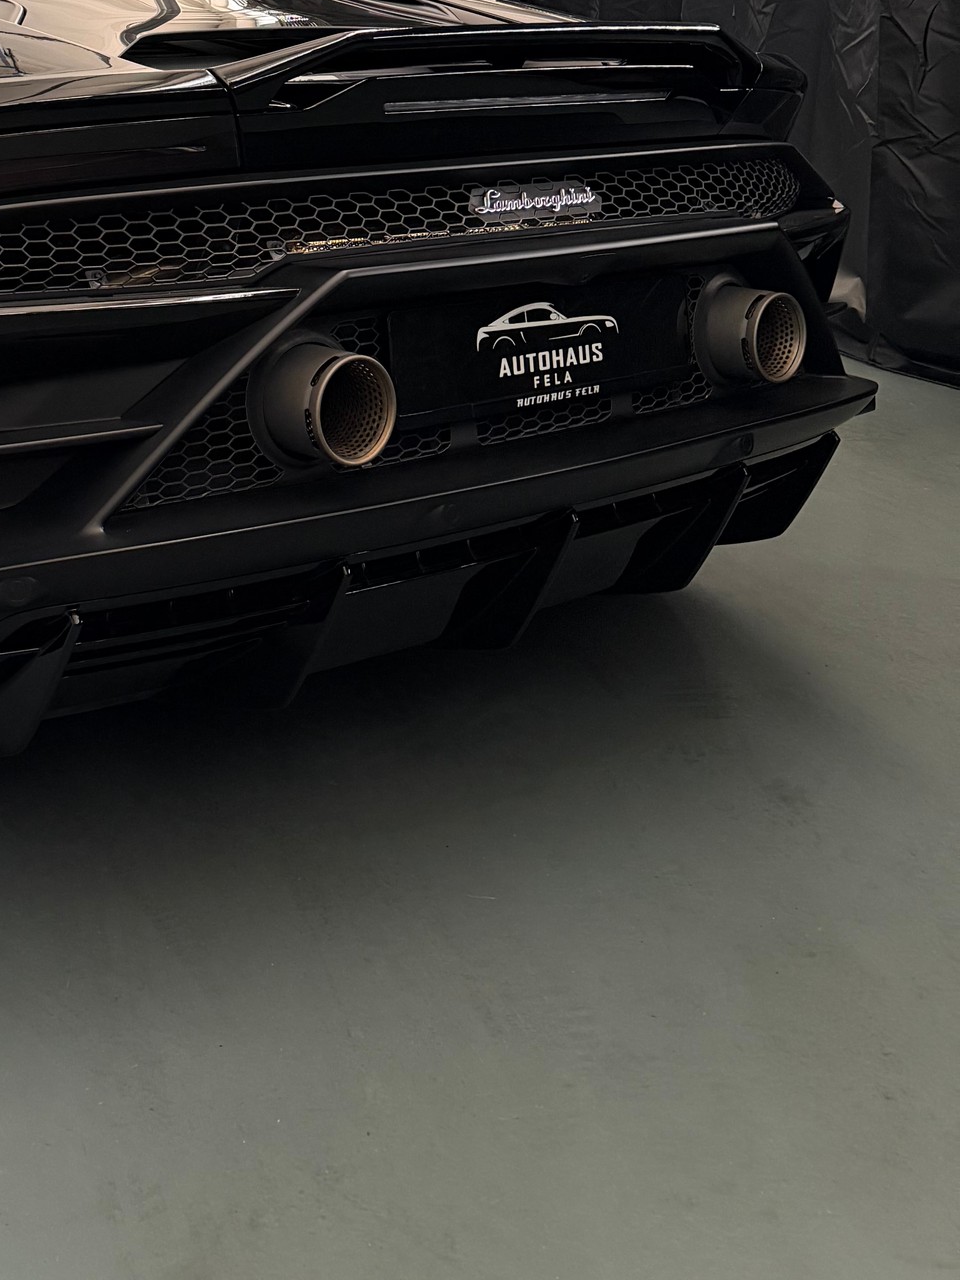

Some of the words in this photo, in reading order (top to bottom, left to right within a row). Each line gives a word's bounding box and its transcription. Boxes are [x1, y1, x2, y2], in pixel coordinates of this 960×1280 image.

[475, 186, 595, 213] Lamborghini
[499, 342, 603, 378] AUTOHAUS
[534, 371, 572, 388] FELA
[517, 390, 572, 408] AUTOHAUS
[575, 385, 600, 397] FELA
